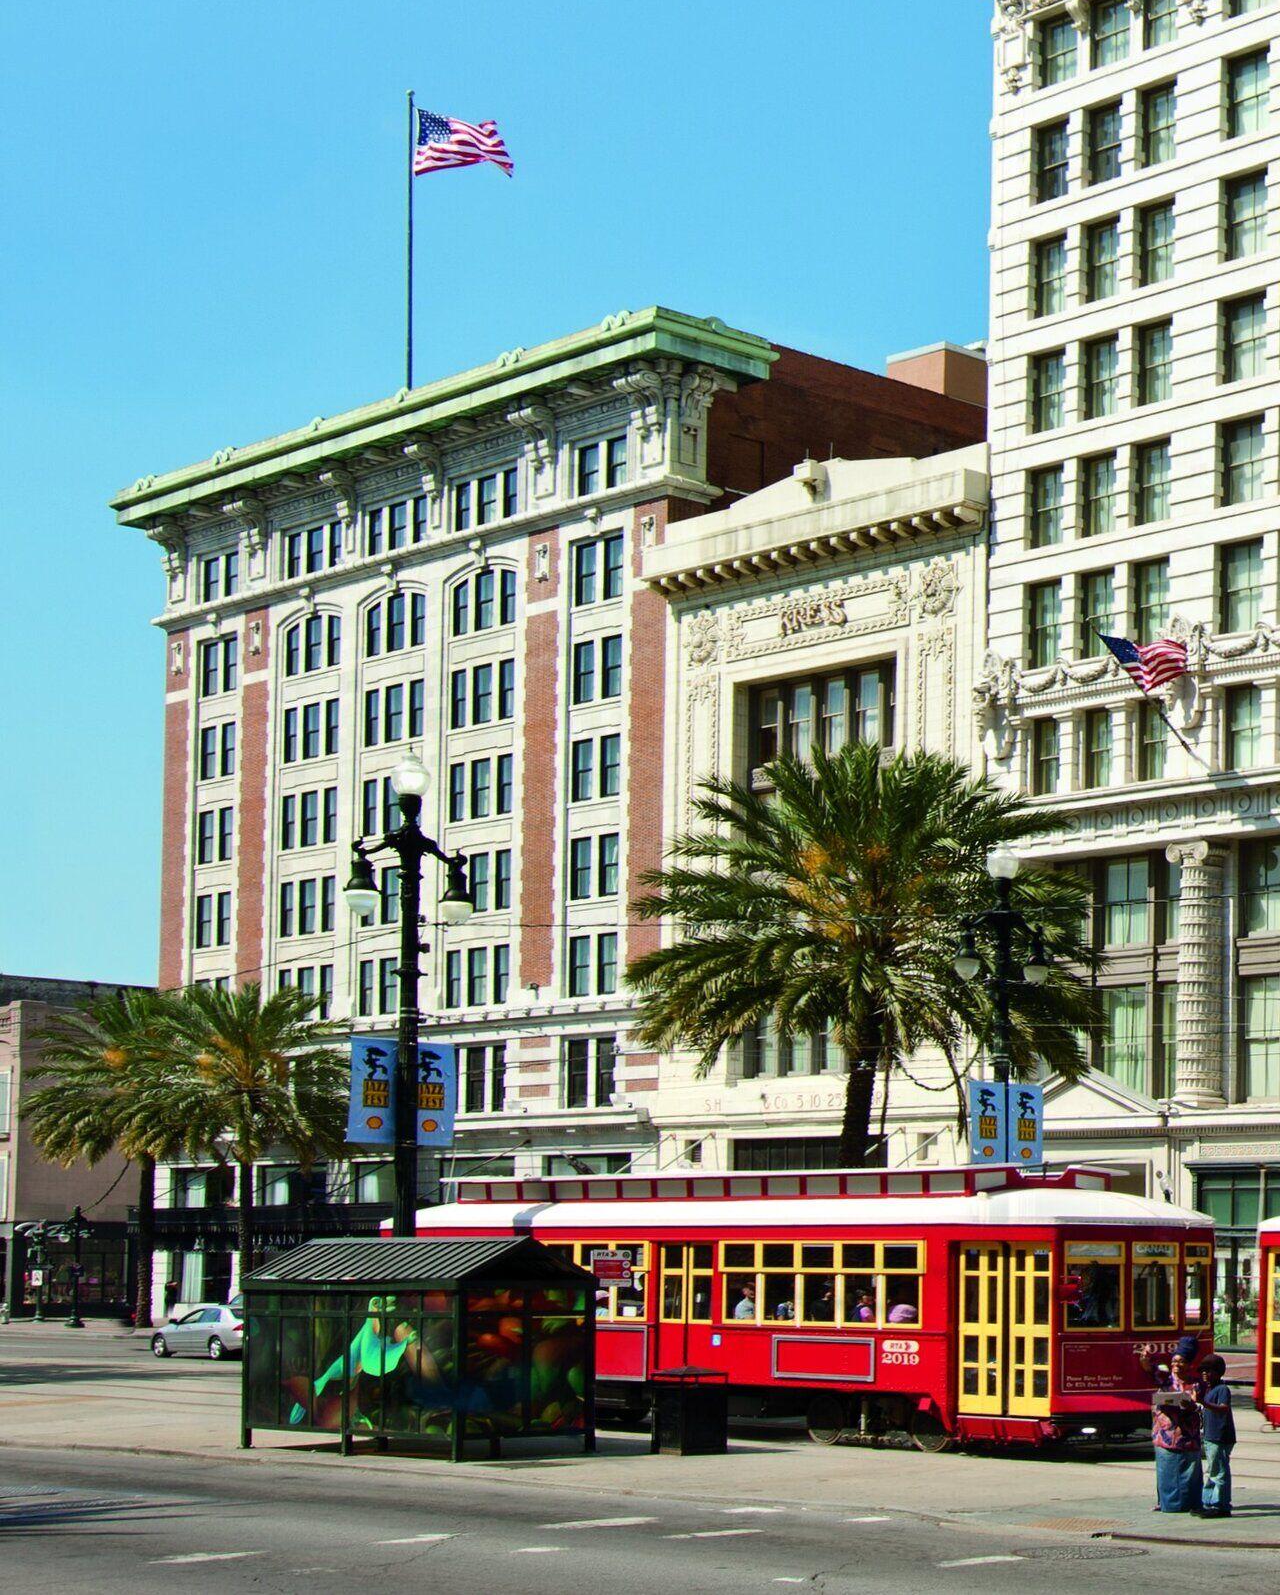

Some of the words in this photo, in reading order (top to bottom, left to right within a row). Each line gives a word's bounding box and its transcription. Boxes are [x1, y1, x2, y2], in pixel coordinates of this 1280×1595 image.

[778, 600, 848, 638] KRESS
[364, 1081, 388, 1093] JAZZ
[419, 1084, 443, 1095] JAZZ
[364, 1093, 389, 1106] FEST
[419, 1096, 443, 1108] FEST
[266, 1234, 303, 1245] SAINT
[1132, 1342, 1178, 1355] 2019
[881, 1352, 920, 1365] 2019
